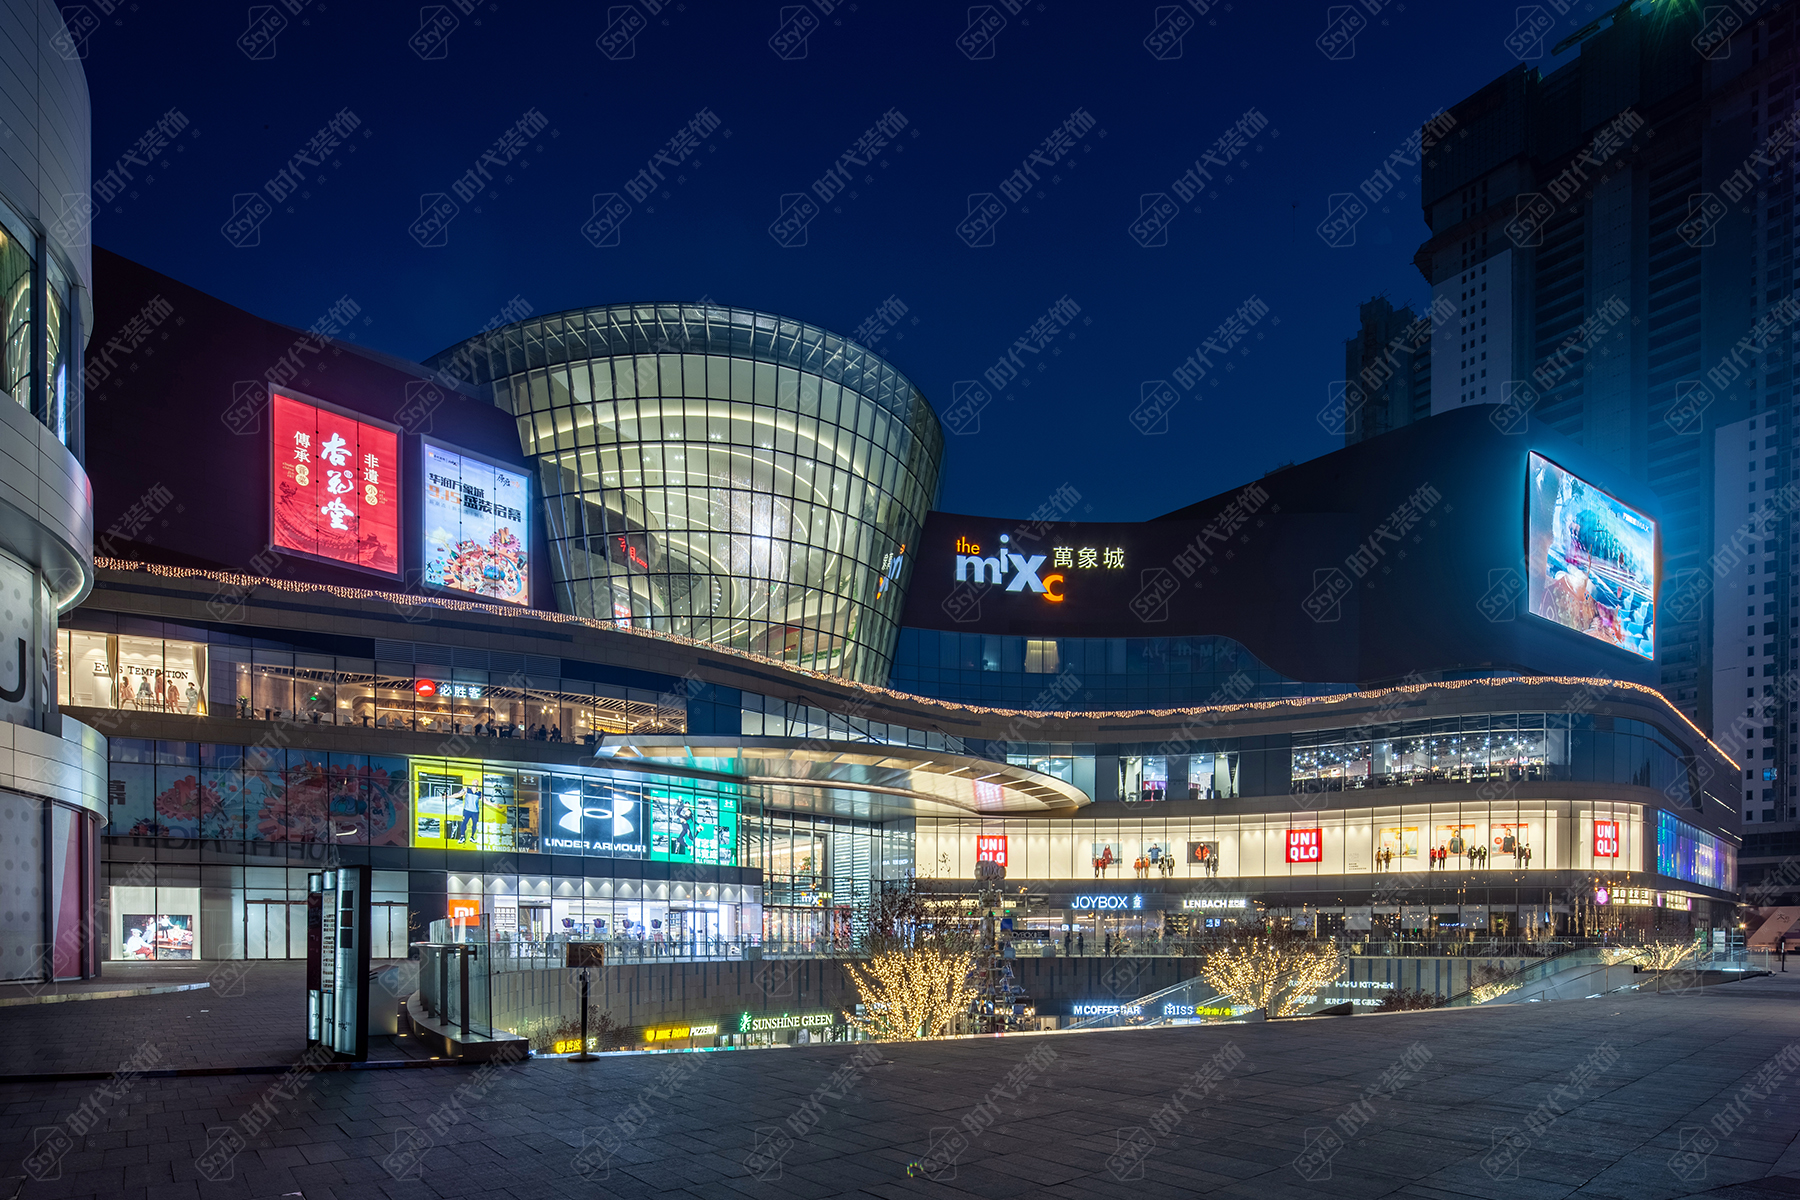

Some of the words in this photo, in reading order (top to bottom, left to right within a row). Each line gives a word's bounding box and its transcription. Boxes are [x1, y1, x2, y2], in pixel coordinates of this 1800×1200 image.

[429, 472, 485, 498] 华润万象城
[429, 485, 461, 504] 9.15
[463, 494, 521, 522] 盛装启幕
[956, 536, 980, 554] the
[1053, 546, 1125, 569] 萬象城
[440, 684, 481, 699] 必胜客
[1290, 832, 1316, 846] UNI
[1597, 825, 1616, 838] UNI
[544, 838, 590, 849] UNDER
[592, 841, 647, 853] ARMOUR
[980, 838, 1003, 851] UNI
[1597, 840, 1617, 855] QLO
[1290, 846, 1318, 861] QLO
[1071, 896, 1128, 909] JOYBOX
[1184, 899, 1228, 908] LENBACH
[752, 1015, 800, 1030] SUNSHINE
[801, 1013, 833, 1026] GREEN
